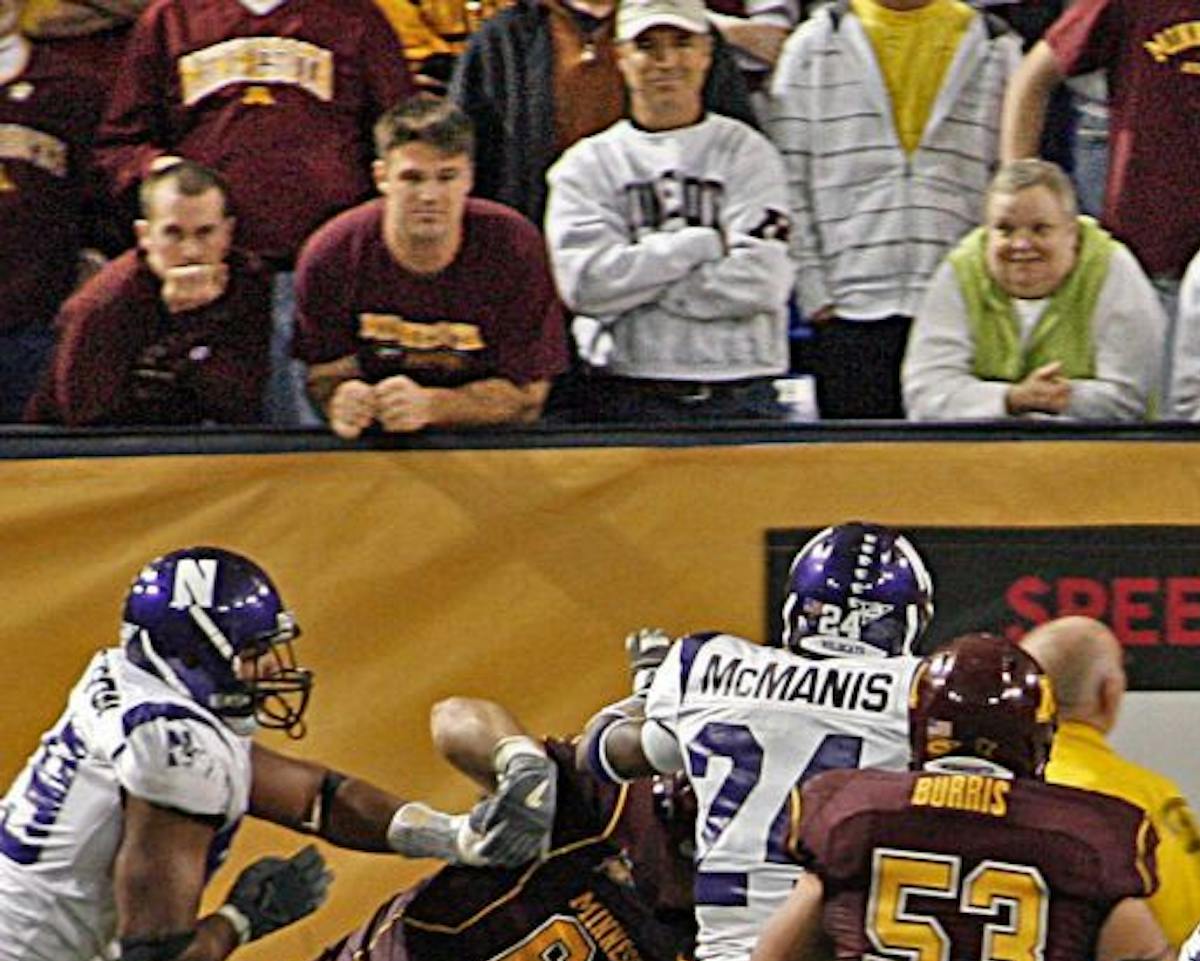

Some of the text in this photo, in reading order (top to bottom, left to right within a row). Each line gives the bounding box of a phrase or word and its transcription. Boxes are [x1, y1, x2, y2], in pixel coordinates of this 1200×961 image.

[169, 559, 217, 609] N
[818, 603, 860, 640] 24
[701, 654, 893, 712] McMANIS
[911, 774, 1011, 816] BURRIS
